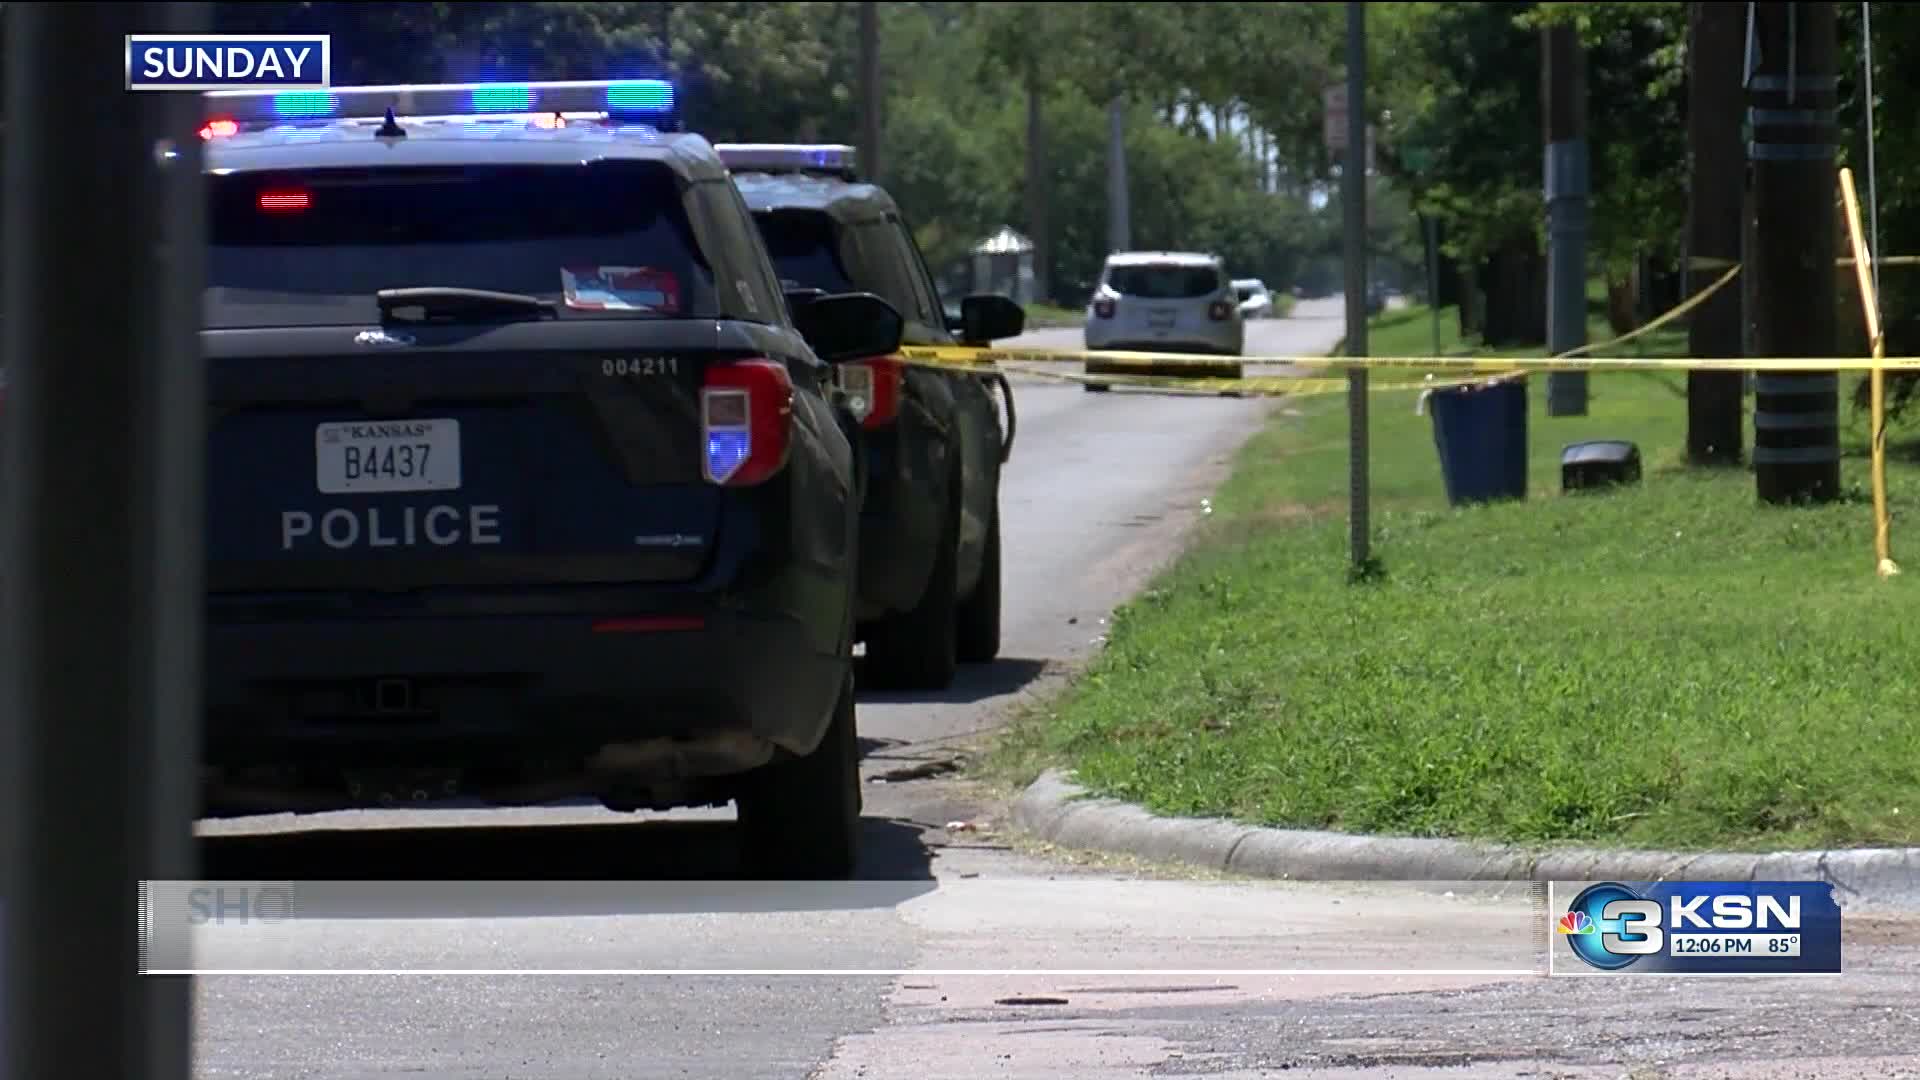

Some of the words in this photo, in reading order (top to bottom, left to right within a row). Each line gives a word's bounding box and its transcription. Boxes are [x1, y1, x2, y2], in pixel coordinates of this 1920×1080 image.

[601, 358, 679, 376] 004211
[351, 423, 425, 439] KANSAS
[344, 444, 431, 479] B4437
[281, 504, 500, 550] POLICE
